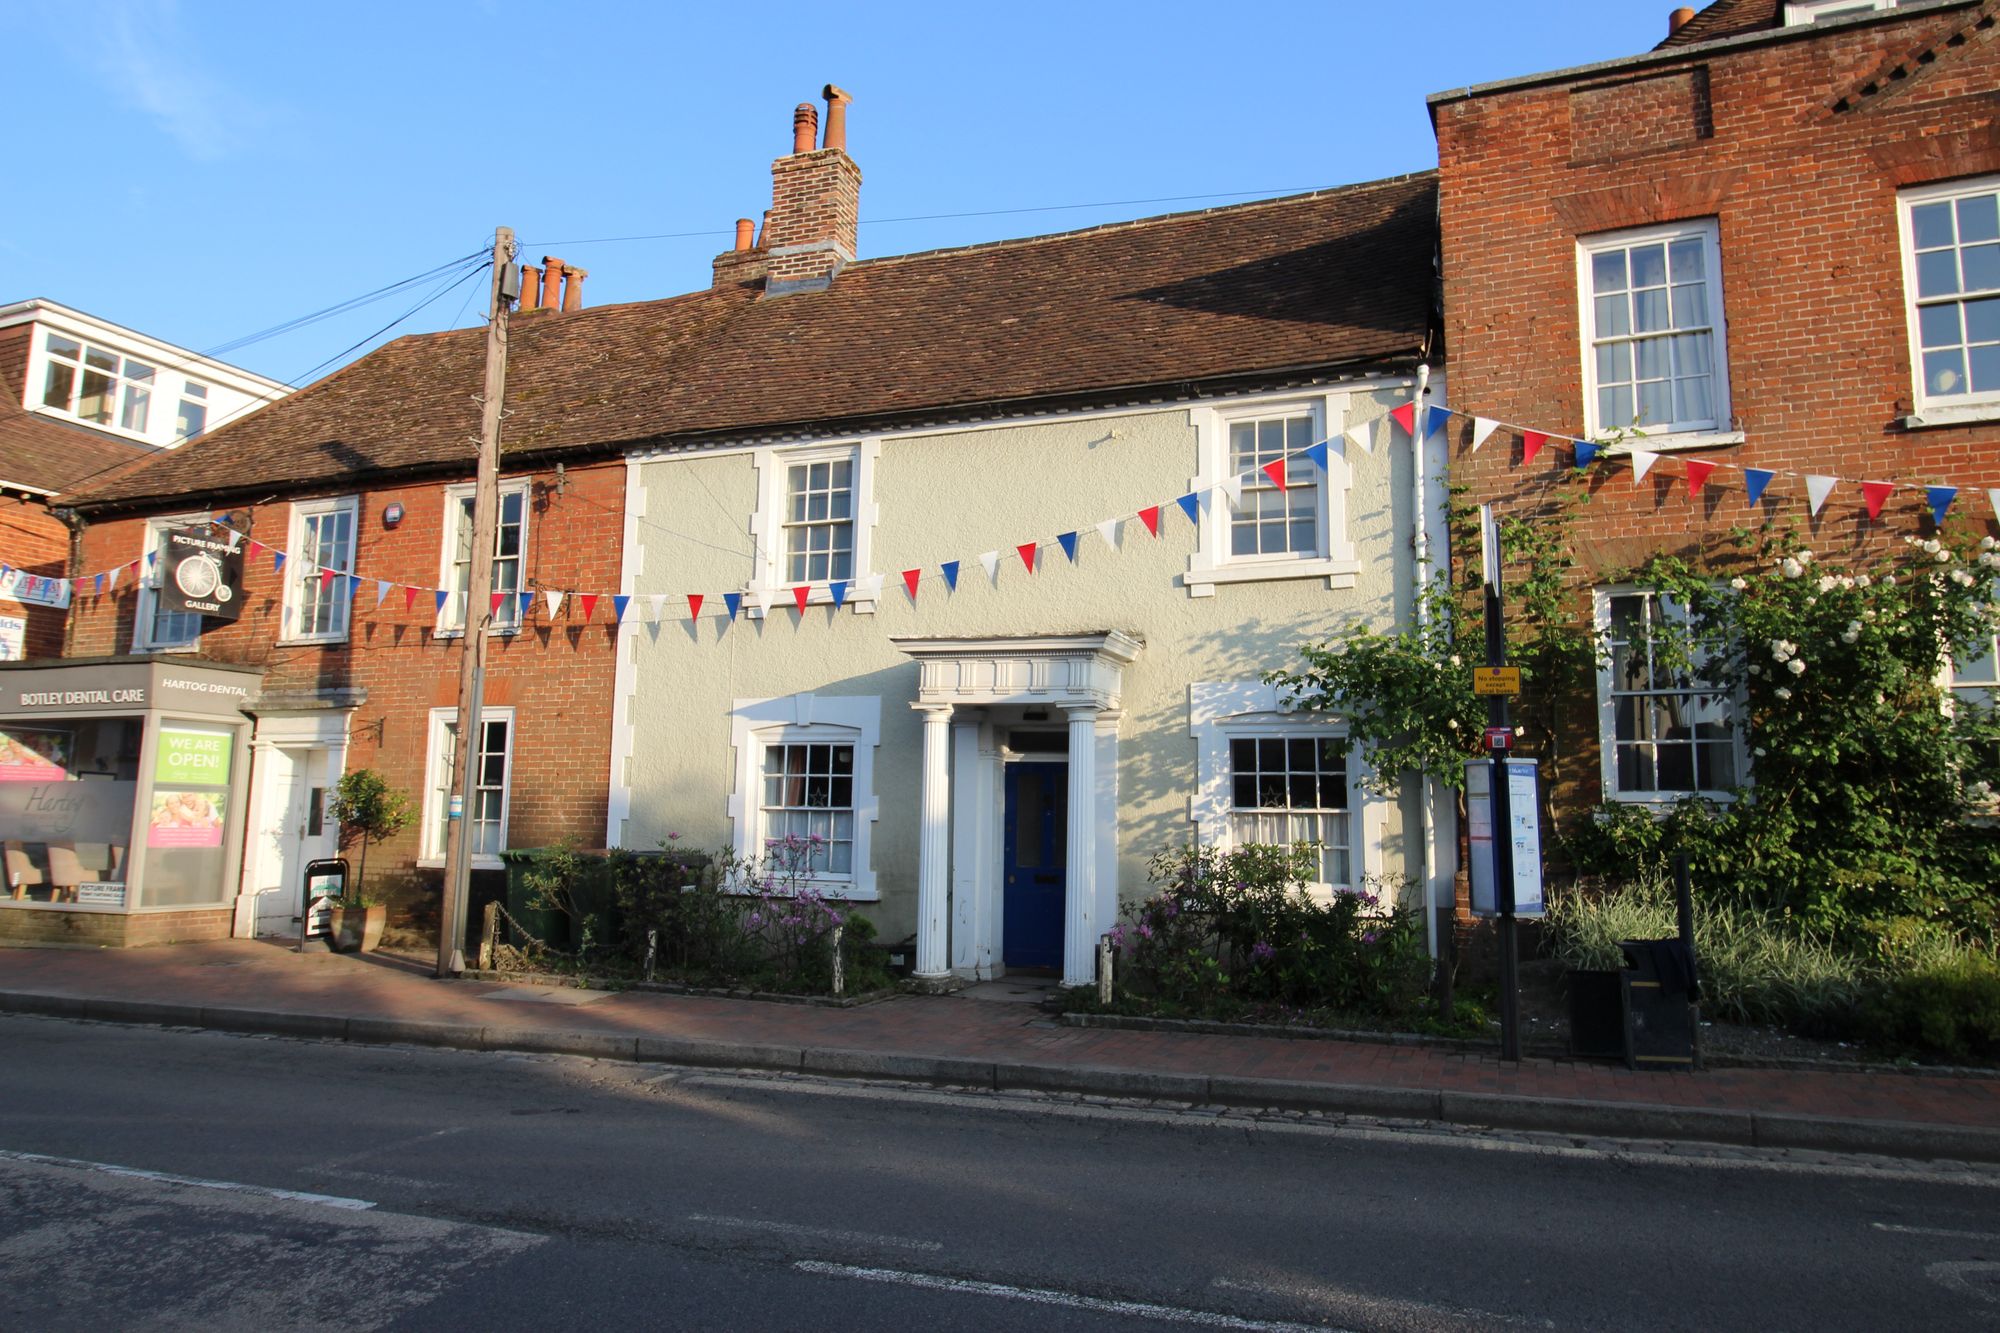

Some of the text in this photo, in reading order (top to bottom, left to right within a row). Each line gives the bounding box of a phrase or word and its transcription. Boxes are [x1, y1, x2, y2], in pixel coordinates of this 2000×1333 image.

[173, 535, 241, 555] PICTURE FRAMNG
[185, 600, 221, 612] GALLERY
[162, 679, 249, 696] HARTOG DENTAL
[20, 689, 145, 706] BOTLEY DENTAL CARE
[169, 737, 220, 752] WE ARE
[168, 752, 220, 768] OPEN!
